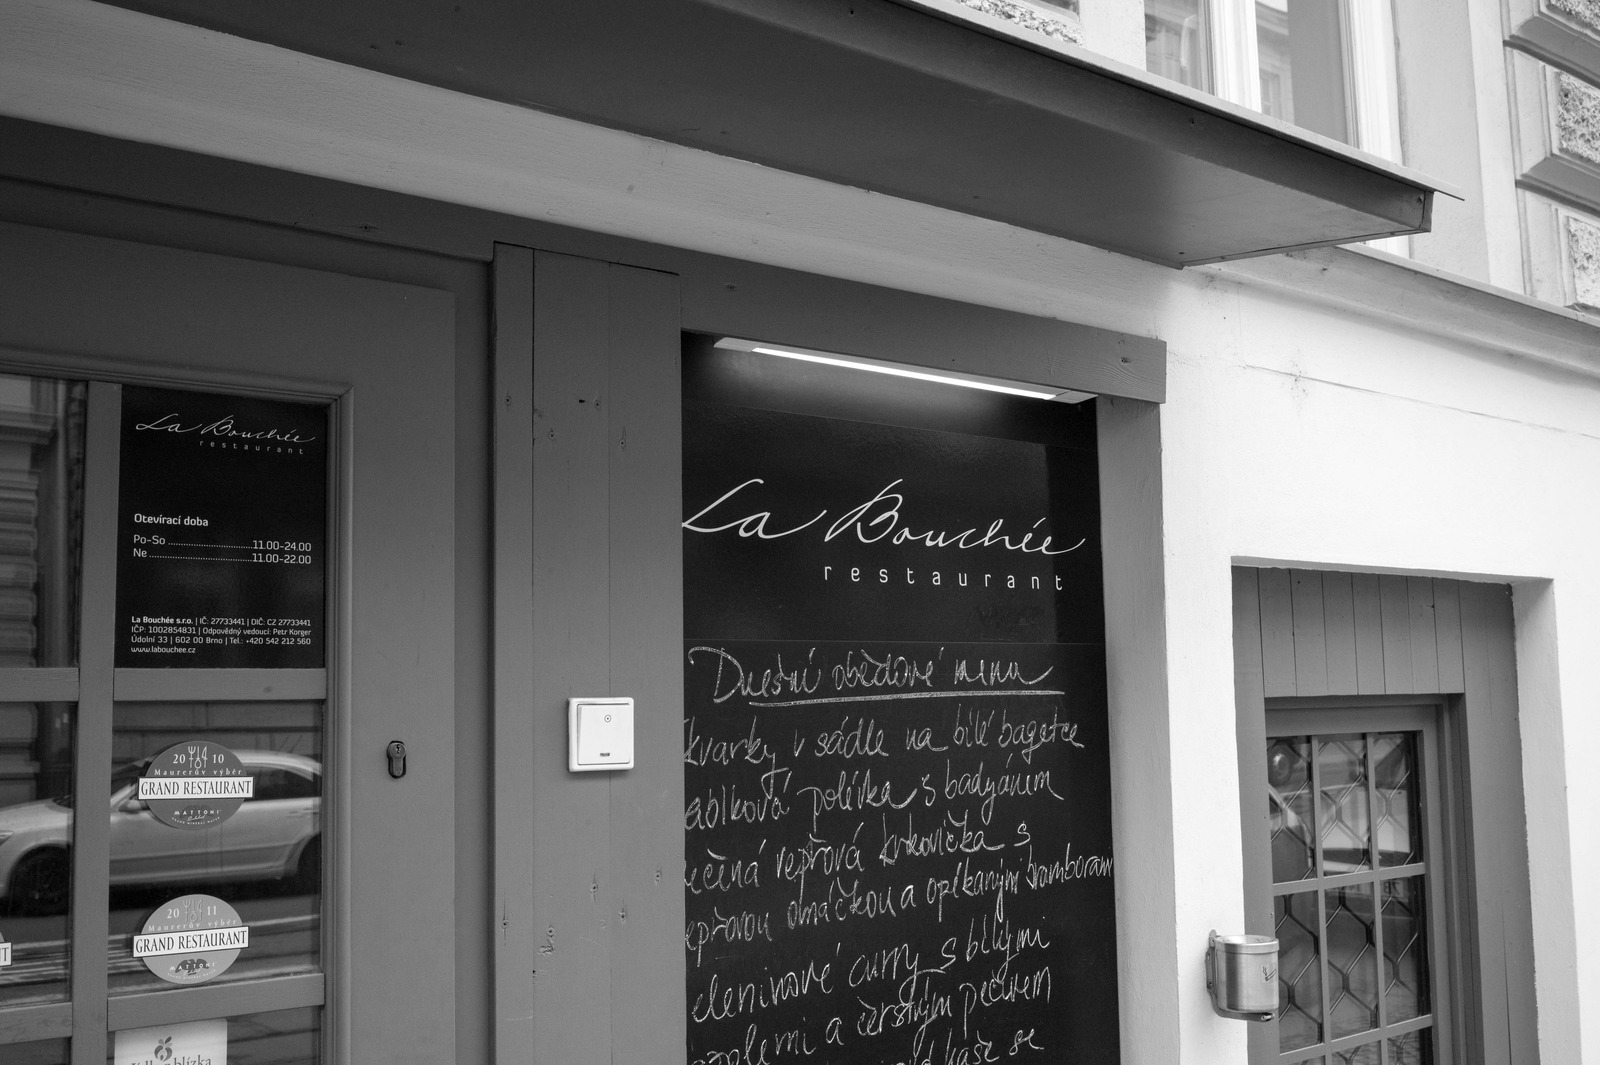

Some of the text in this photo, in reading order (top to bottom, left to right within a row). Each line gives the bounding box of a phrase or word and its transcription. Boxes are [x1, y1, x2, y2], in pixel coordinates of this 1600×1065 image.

[135, 413, 316, 443] La Bouchée
[199, 440, 304, 455] restaurant
[134, 513, 209, 527] Otevírací doba
[682, 478, 1086, 555] La Bouchée
[133, 534, 312, 552] Po-So 11.00-24.00
[133, 548, 312, 565] Ne 11.00-22.00
[824, 565, 1063, 591] restaurant
[131, 616, 311, 627] La Bouchée s.r.o. IČ: 27733441 DIČ: CZ 27733441
[131, 625, 312, 638] IČP: 1002854831 Odpovědný vedoucí: Petr Korger
[130, 646, 196, 655] www.labouchee.cz
[131, 635, 156, 644] Údolní
[157, 636, 168, 644] 33
[175, 636, 191, 645] 602
[192, 636, 204, 645] 00
[205, 636, 223, 645] Brno
[245, 637, 264, 645] +420
[265, 637, 280, 645] 542
[687, 646, 822, 703] Dnešní
[954, 656, 1055, 686] menu
[795, 728, 805, 758] v
[814, 715, 889, 758] sádle
[905, 725, 949, 752] na
[172, 753, 225, 764] 20 10
[141, 780, 252, 796] GRAND RESTAURANT
[921, 773, 937, 806] s
[1013, 821, 1031, 848] s
[166, 905, 218, 919] 20 11
[685, 906, 773, 968] epřovou
[900, 884, 917, 911] a
[135, 930, 247, 954] GRAND RESTAURANT
[691, 942, 841, 1023] eleninové
[939, 936, 957, 970] s
[825, 1016, 845, 1046] a
